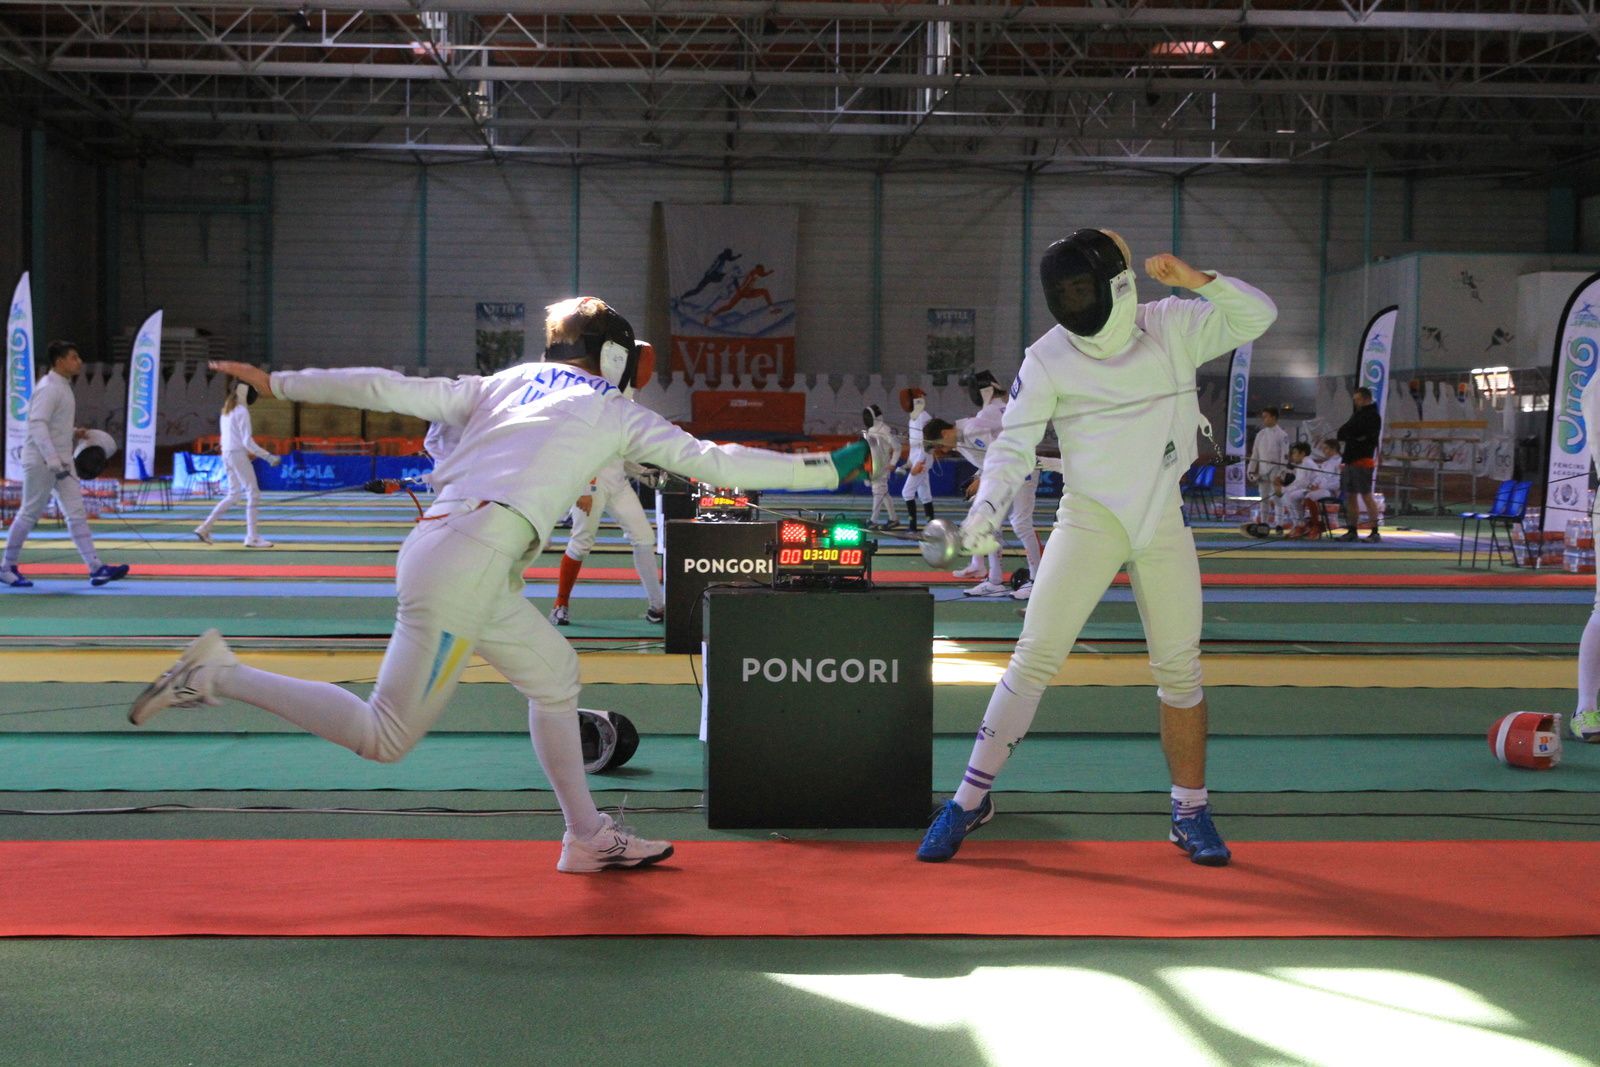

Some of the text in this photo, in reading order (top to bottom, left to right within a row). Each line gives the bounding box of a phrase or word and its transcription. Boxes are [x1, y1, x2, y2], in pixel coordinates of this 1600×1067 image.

[677, 341, 784, 382] Vittel
[684, 557, 773, 574] PONGORI
[780, 549, 862, 565] 00 03:00 00
[742, 657, 899, 683] PONGORI
